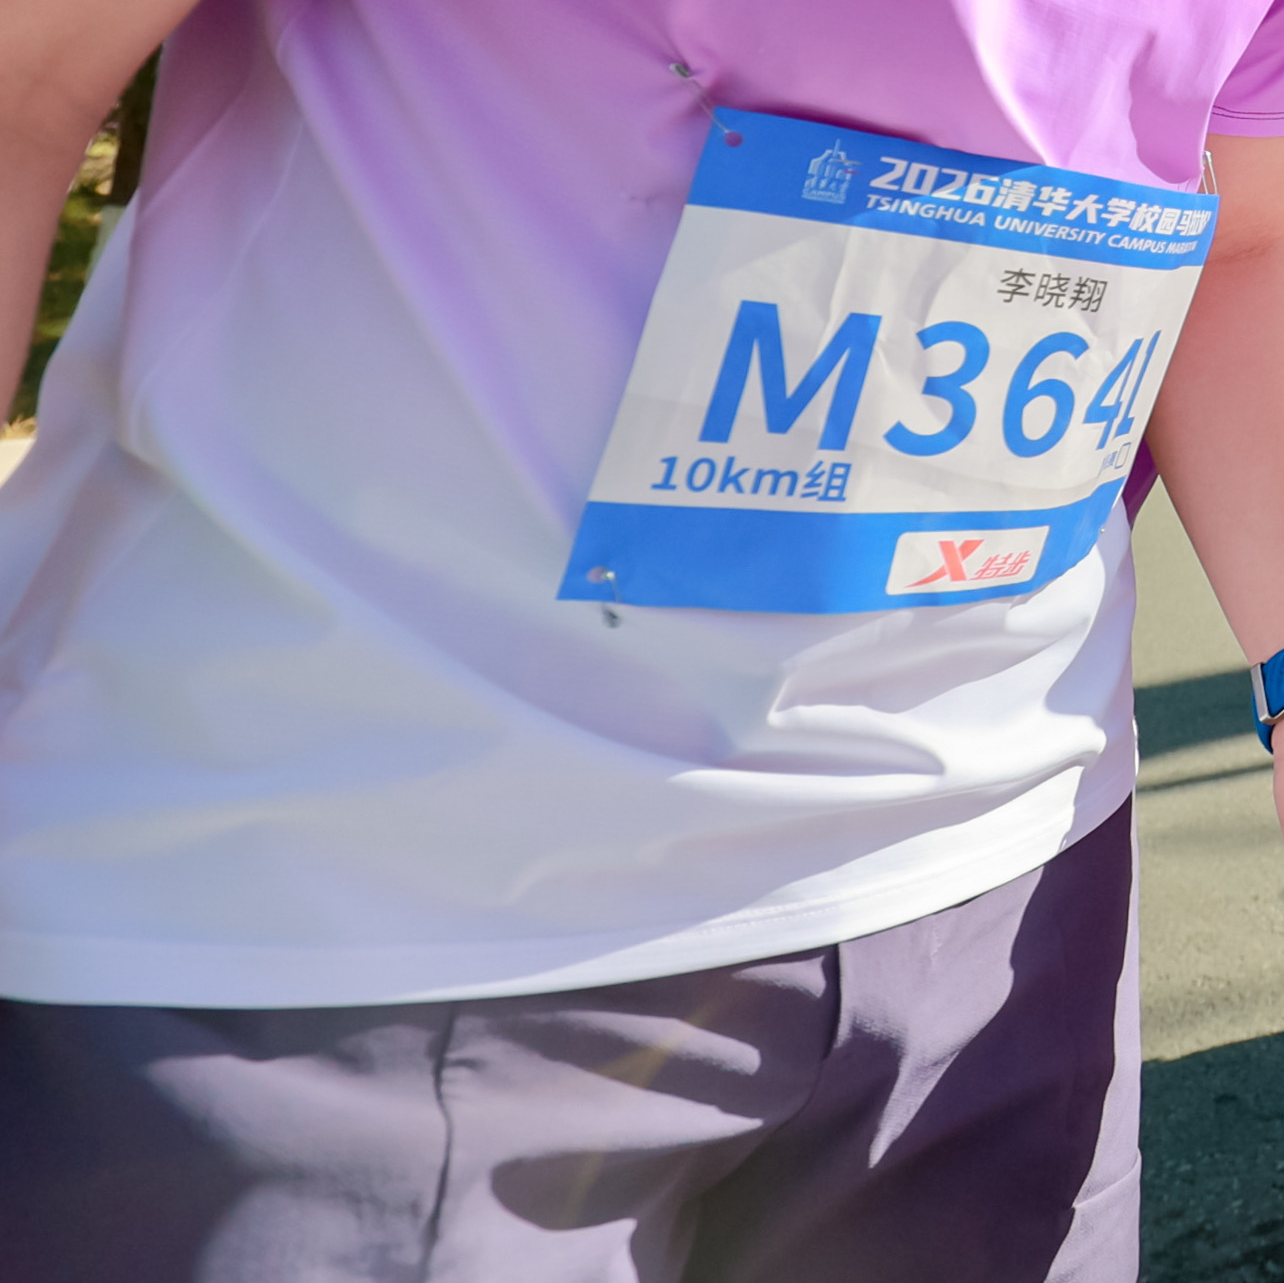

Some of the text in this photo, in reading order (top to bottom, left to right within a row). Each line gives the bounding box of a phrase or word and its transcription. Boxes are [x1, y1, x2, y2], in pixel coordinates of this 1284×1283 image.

[866, 194, 987, 227] TSINGHUA
[994, 215, 1106, 245] UNIVERSITY
[1107, 234, 1166, 254] CAMPUS
[997, 268, 1108, 313] 李晓翔
[651, 455, 853, 502] 10km组
[969, 550, 1032, 581] 特步
